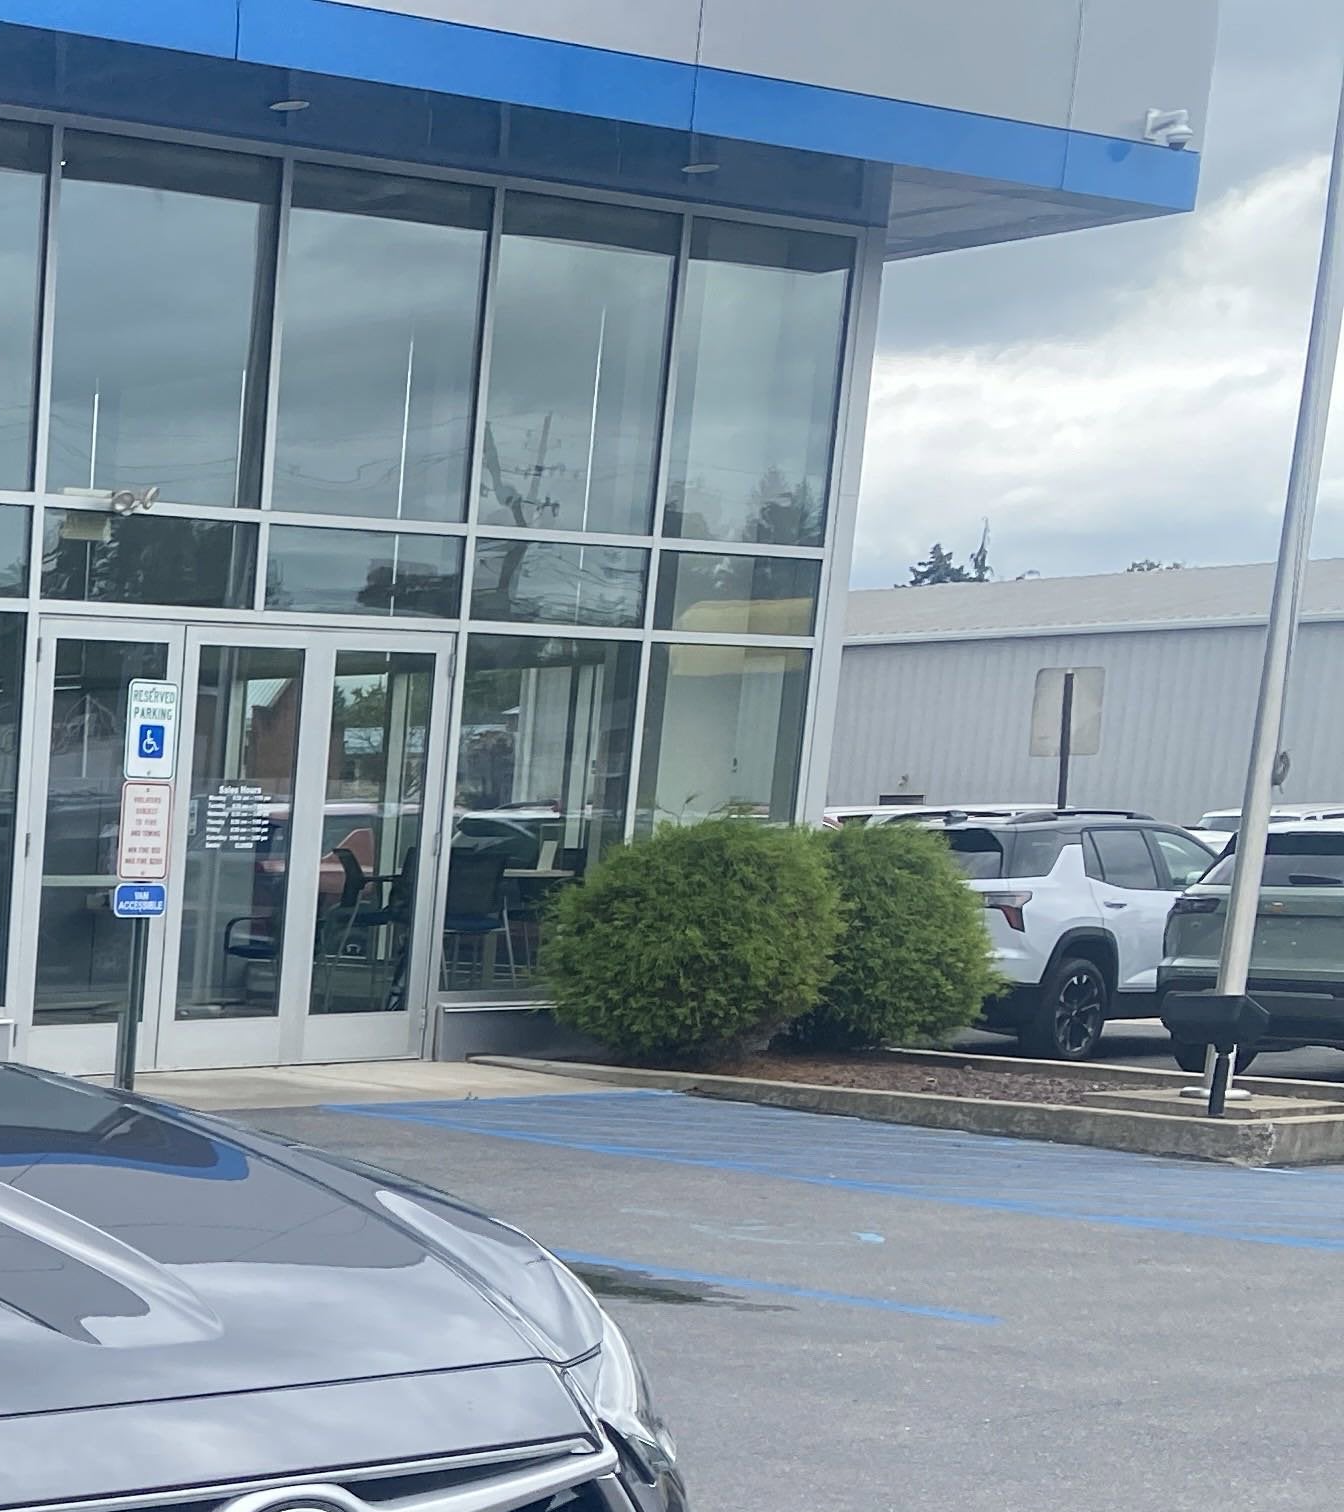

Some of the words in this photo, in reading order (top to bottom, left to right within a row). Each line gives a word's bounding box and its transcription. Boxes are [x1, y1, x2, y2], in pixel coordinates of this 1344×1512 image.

[133, 689, 175, 704] RESERVED
[133, 706, 173, 721] PARKING
[219, 785, 239, 794] Sales
[240, 785, 262, 794] Hours
[134, 891, 150, 900] VAN
[118, 900, 163, 911] ACCESSIBLE
